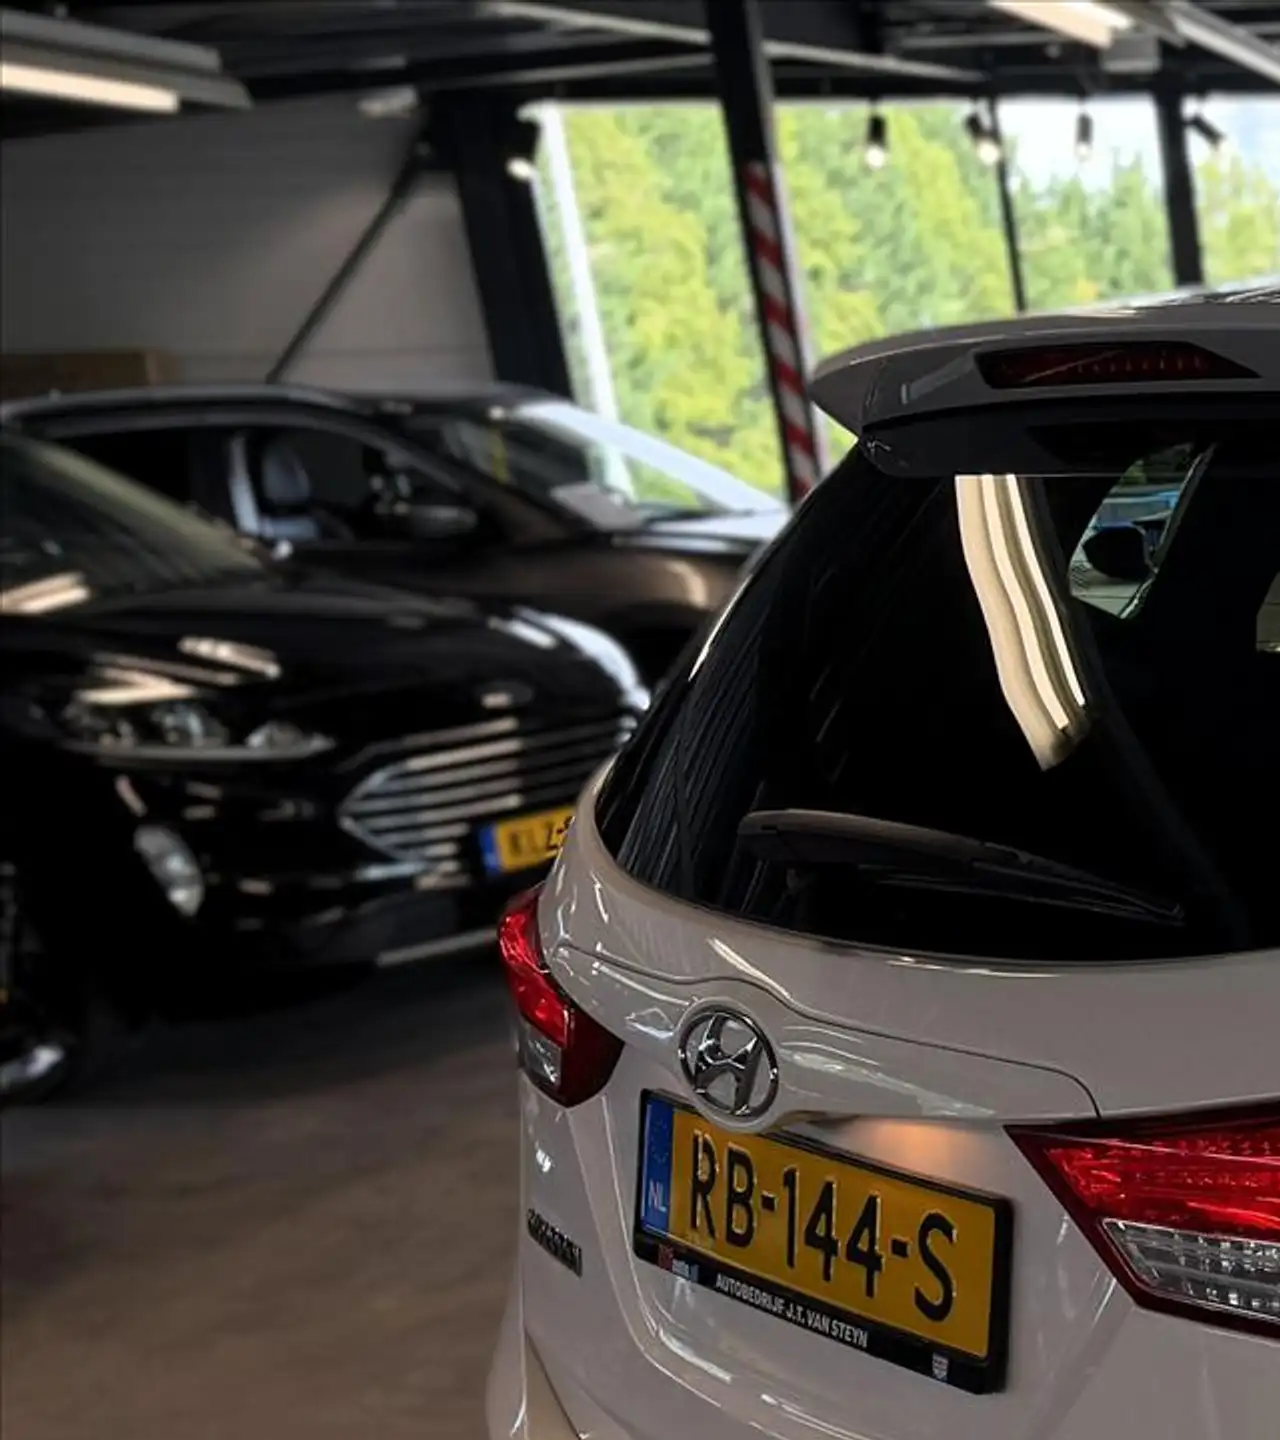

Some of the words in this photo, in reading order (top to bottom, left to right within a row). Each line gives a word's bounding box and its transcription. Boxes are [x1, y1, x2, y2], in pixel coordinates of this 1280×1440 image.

[648, 1179, 667, 1215] NL
[690, 1130, 957, 1322] RB-144-S
[715, 1273, 786, 1314] AUTOBEDRIJF
[786, 1302, 806, 1324] J.T.
[806, 1310, 830, 1334] VAN
[831, 1319, 869, 1348] STEYN
